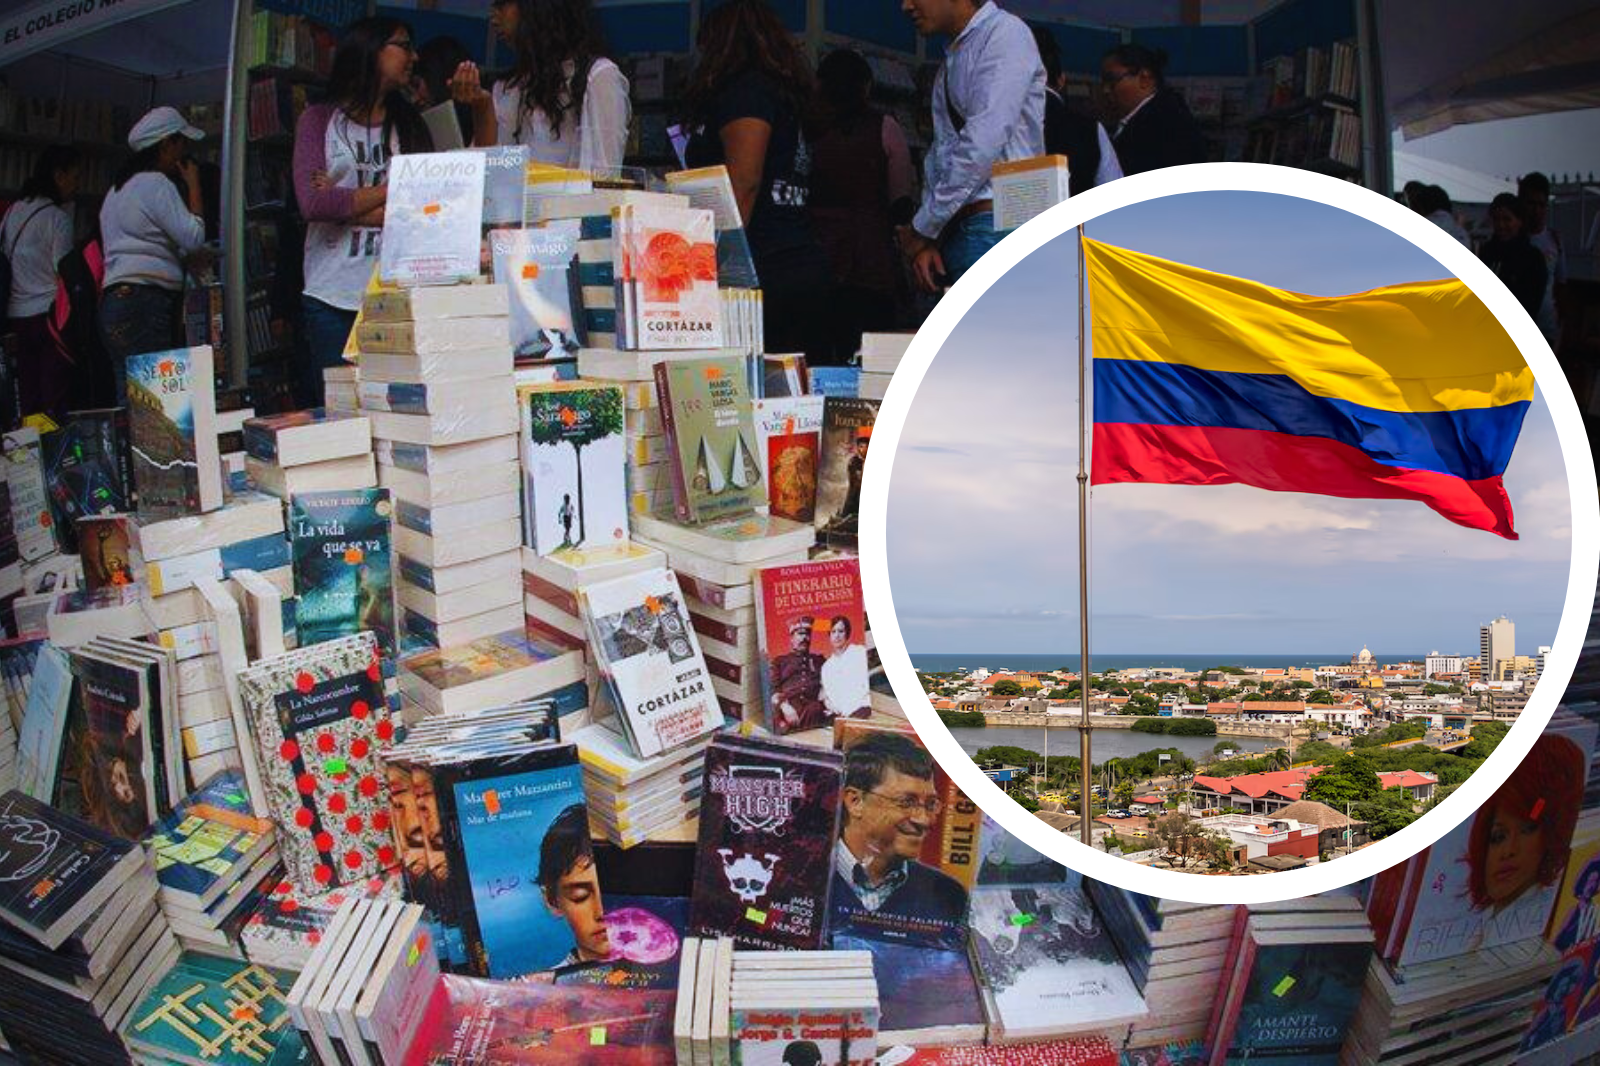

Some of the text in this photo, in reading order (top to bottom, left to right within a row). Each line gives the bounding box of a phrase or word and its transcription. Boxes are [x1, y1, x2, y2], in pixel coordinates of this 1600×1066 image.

[4, 0, 94, 45] EL COLEGIO
[399, 157, 475, 179] Momo
[486, 155, 523, 170] mago
[646, 320, 713, 332] CORTÁZAR
[161, 378, 186, 394] SOL
[536, 408, 591, 424] Sarago
[299, 520, 345, 537] La vida
[322, 540, 380, 558] que se va
[774, 573, 853, 596] ITINERARIO
[775, 596, 790, 609] DE
[791, 592, 814, 606] UNA
[637, 681, 706, 715] CORTÁZAR
[709, 774, 806, 798] MONSTER
[464, 789, 512, 804] Marret
[726, 794, 791, 818] HIGH
[950, 822, 976, 866] BILL
[791, 915, 811, 927] QUE
[733, 932, 801, 951] ARRISO
[1251, 1014, 1318, 1028] AMANTE
[738, 1027, 778, 1041] Jorge
[1257, 1025, 1338, 1041] DESPIERTO
